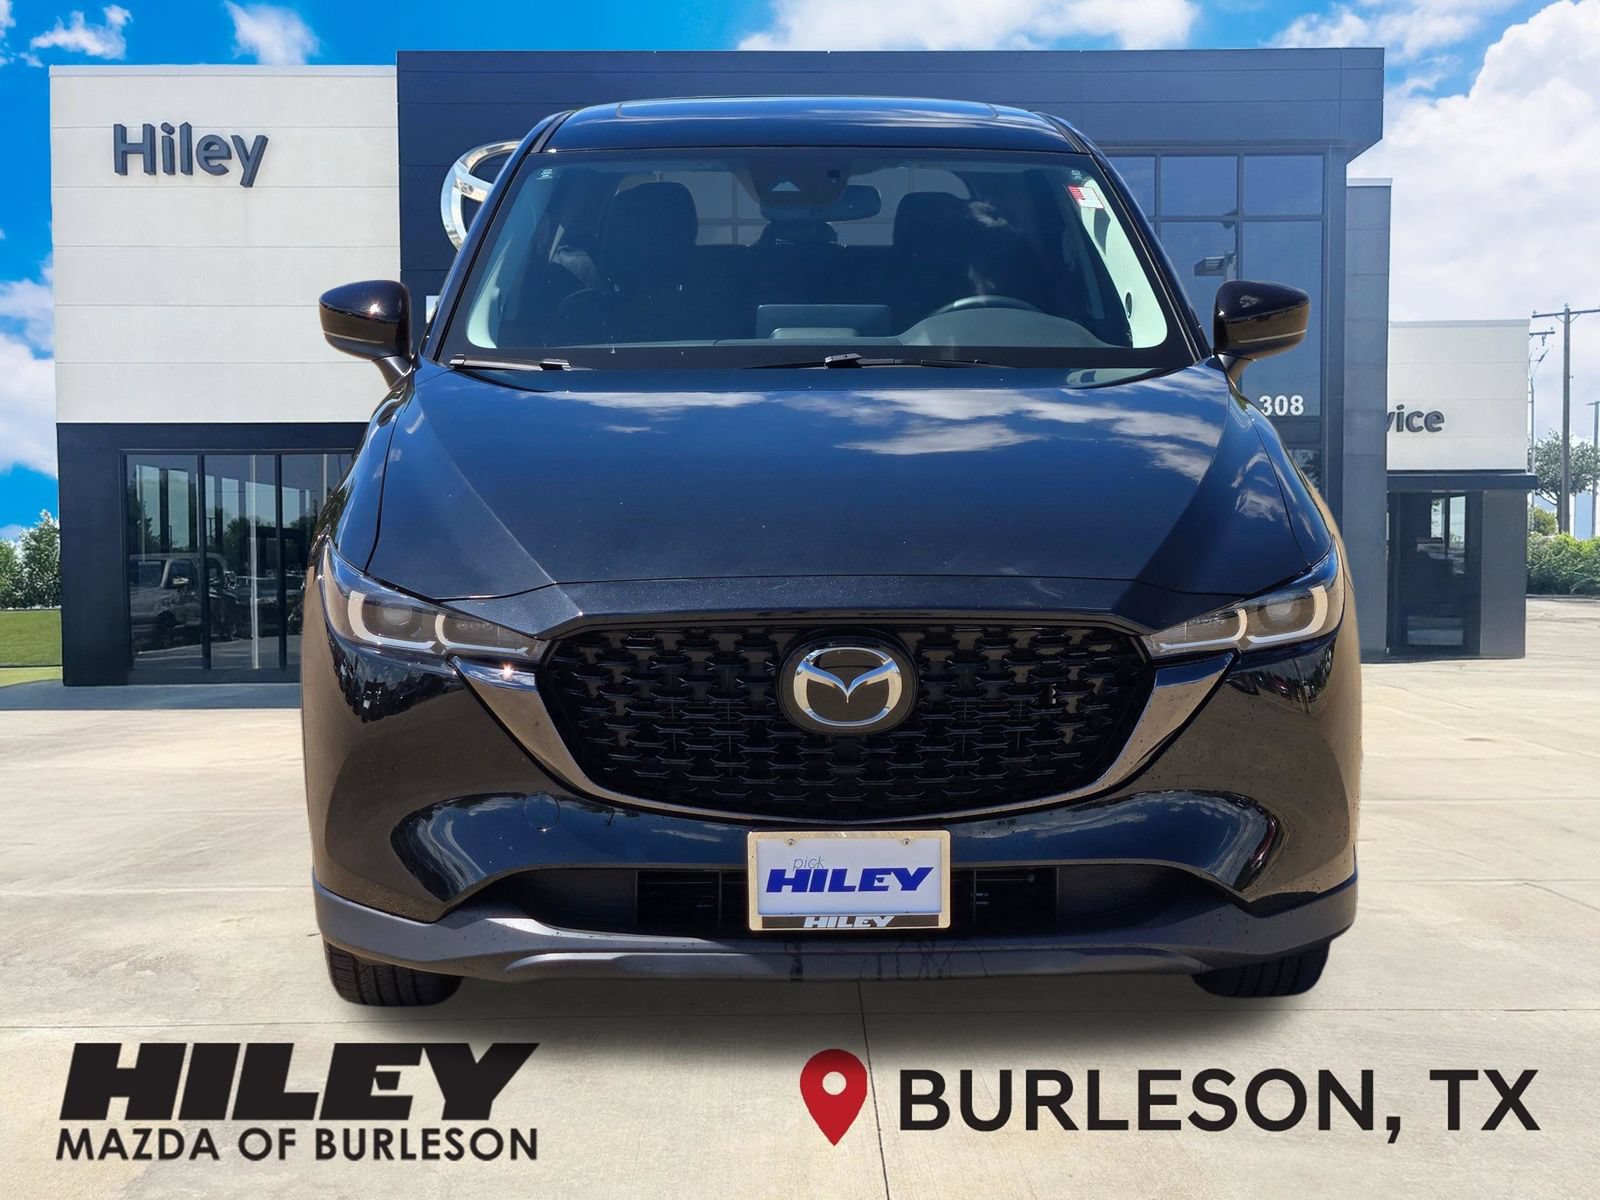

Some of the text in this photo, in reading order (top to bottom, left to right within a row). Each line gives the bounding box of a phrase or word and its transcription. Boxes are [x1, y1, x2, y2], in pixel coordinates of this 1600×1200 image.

[113, 122, 269, 188] Hiley
[1259, 395, 1305, 417] 308
[793, 855, 826, 870] pick
[766, 867, 934, 893] HILEY
[803, 915, 896, 929] HILEY
